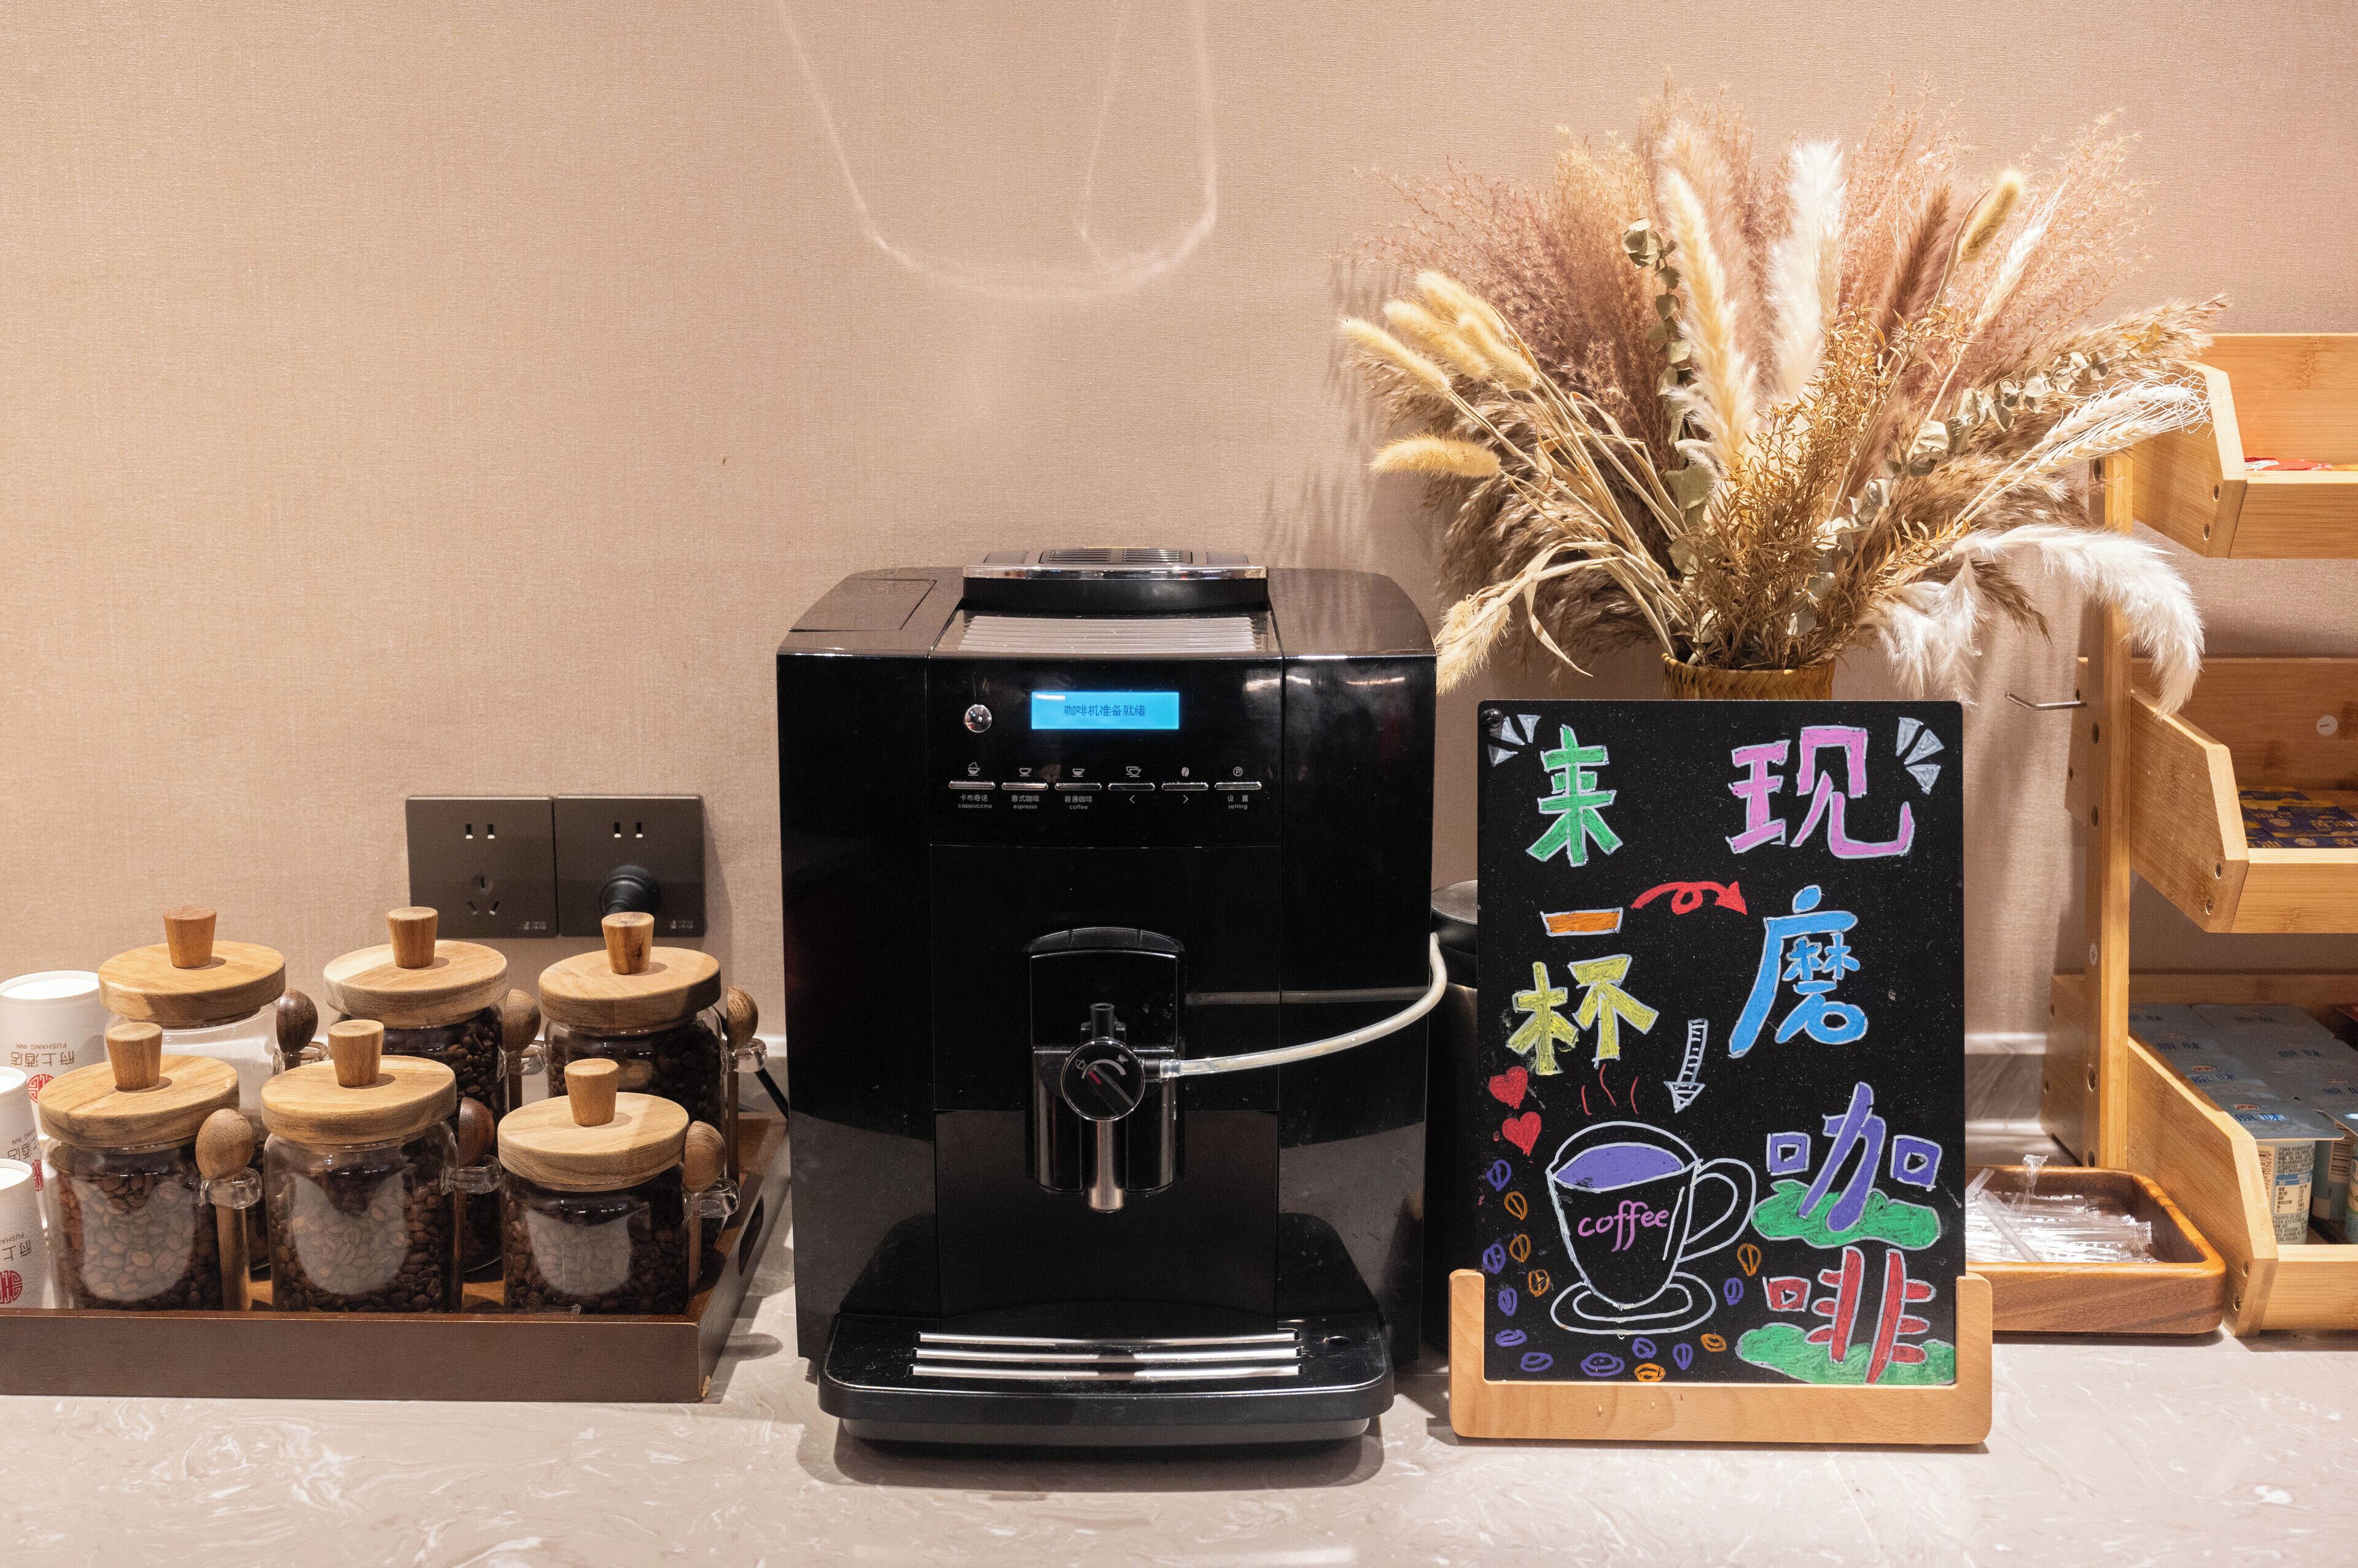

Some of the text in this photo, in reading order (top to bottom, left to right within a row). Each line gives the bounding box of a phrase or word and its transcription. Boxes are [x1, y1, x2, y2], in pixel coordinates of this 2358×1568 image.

[1064, 704, 1146, 717] 咖啡机准备就绪
[959, 794, 988, 802] 卡布奇诺
[10, 1050, 74, 1067] 府上酒店
[1577, 1200, 1671, 1252] coffee
[0, 1232, 24, 1244] FUSHA
[2, 1240, 31, 1260] 府上
